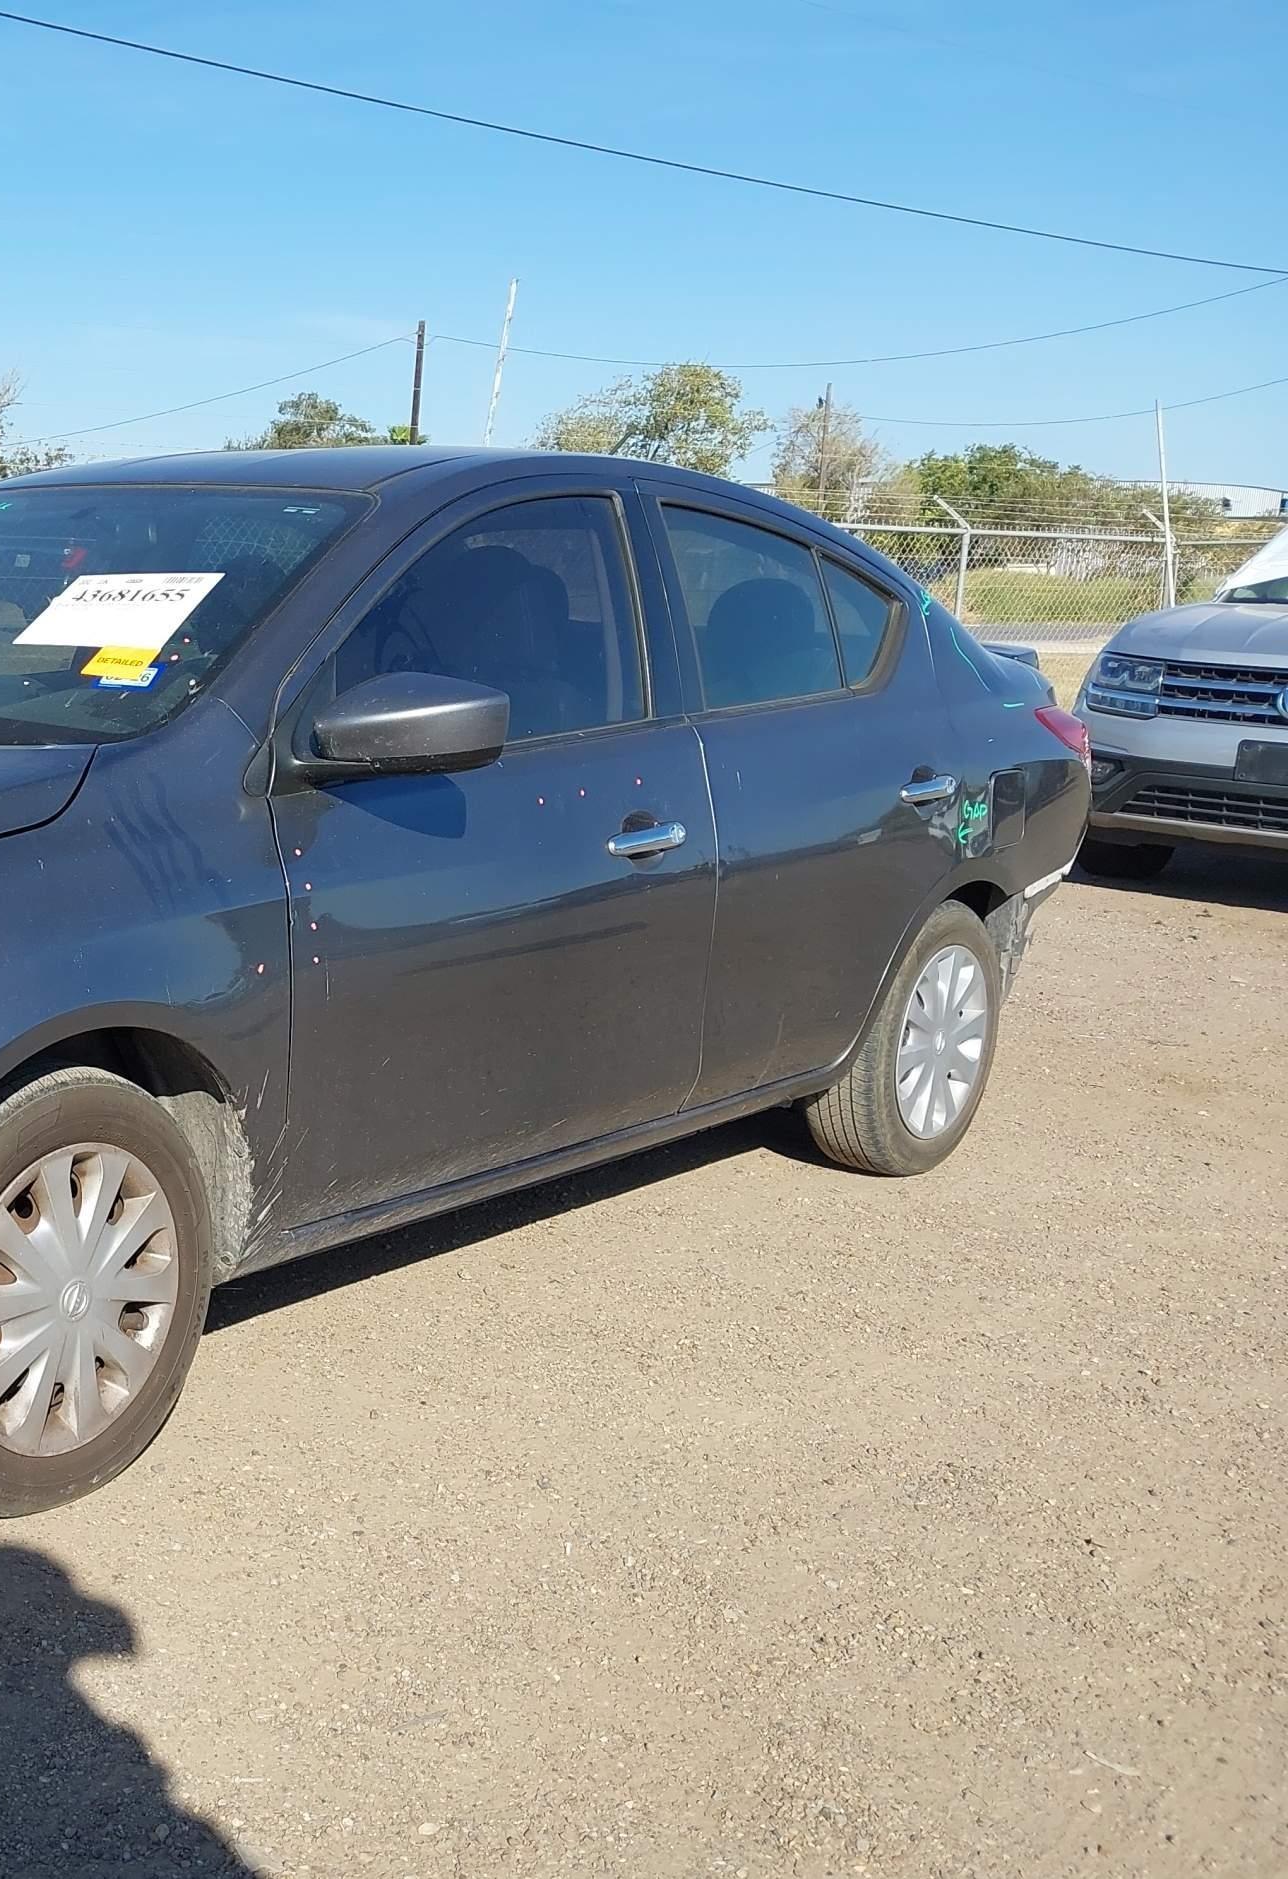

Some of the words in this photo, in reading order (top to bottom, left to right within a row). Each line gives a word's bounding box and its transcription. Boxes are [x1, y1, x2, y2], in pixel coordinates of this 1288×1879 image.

[72, 588, 191, 602] 43681655
[97, 656, 144, 667] DETAILED
[964, 799, 988, 821] GAP
